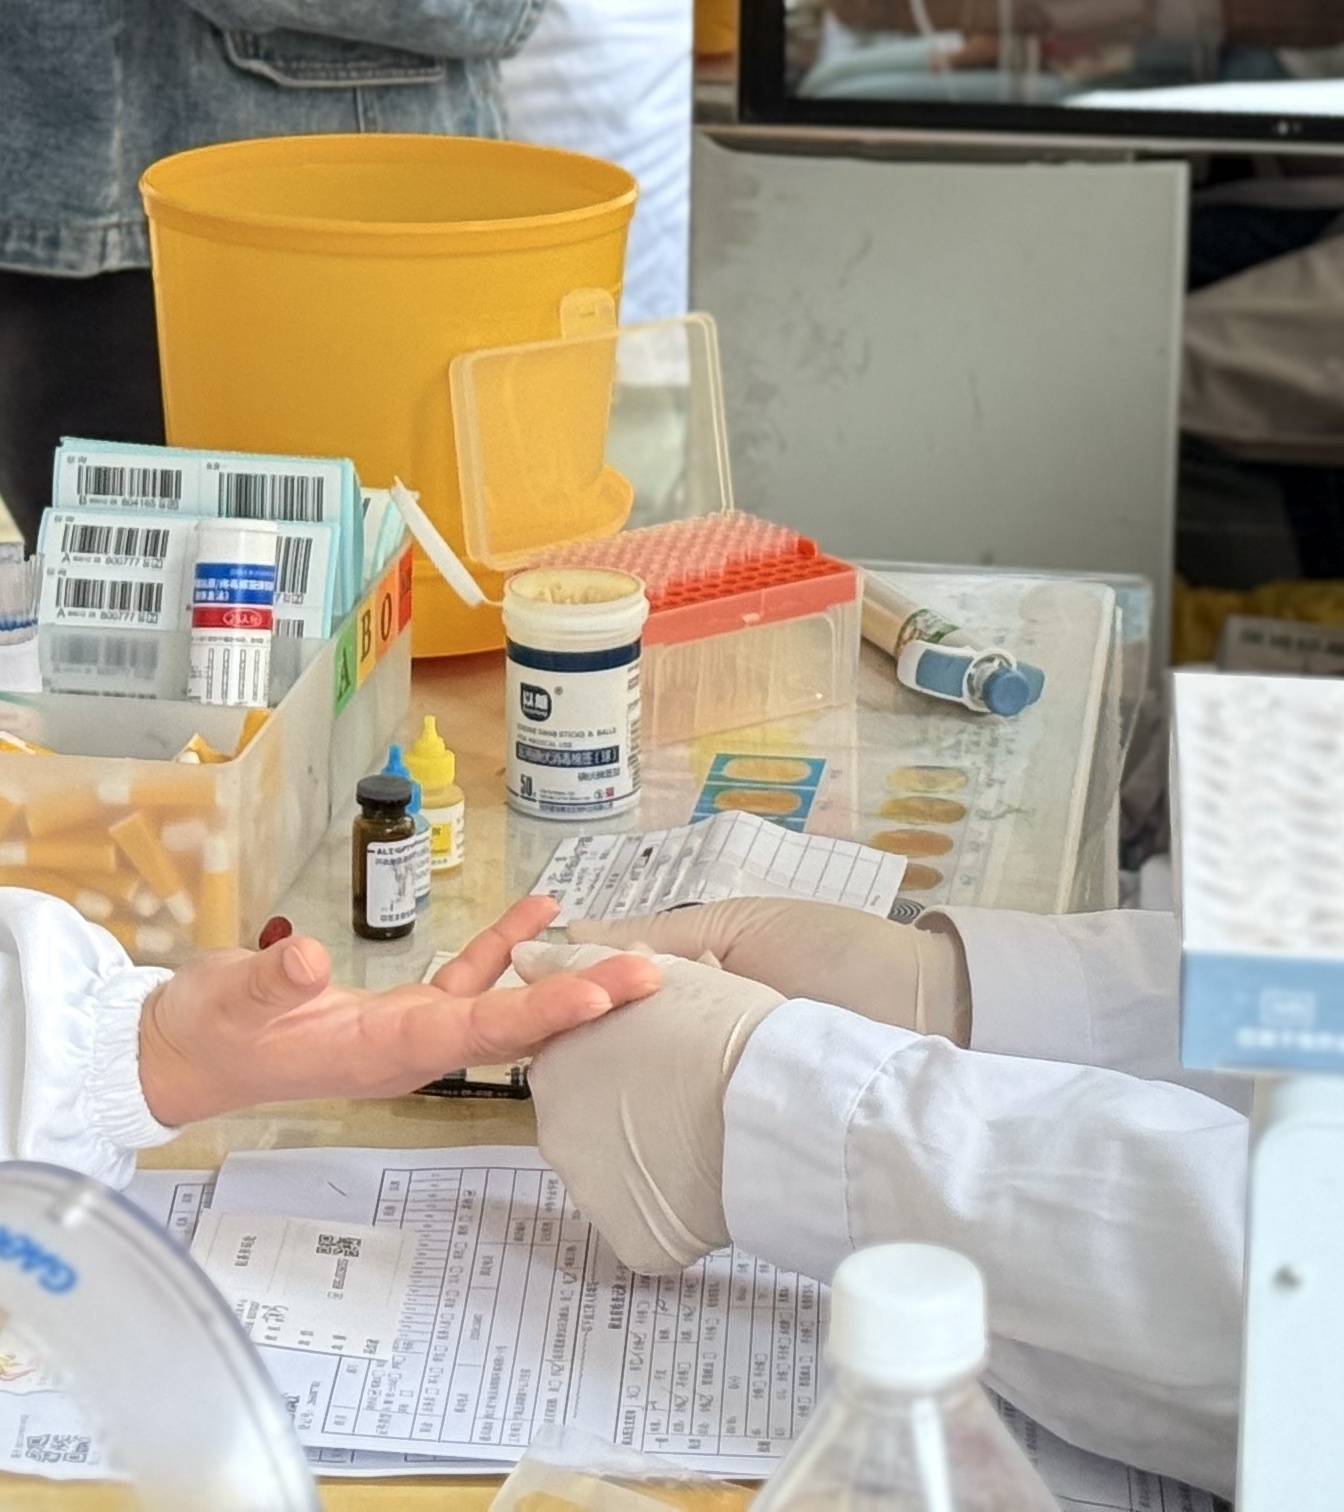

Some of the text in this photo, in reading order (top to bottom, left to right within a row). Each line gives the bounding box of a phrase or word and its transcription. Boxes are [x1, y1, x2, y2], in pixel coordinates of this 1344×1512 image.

[360, 608, 371, 663] B
[381, 592, 392, 642] O
[337, 648, 351, 702] A
